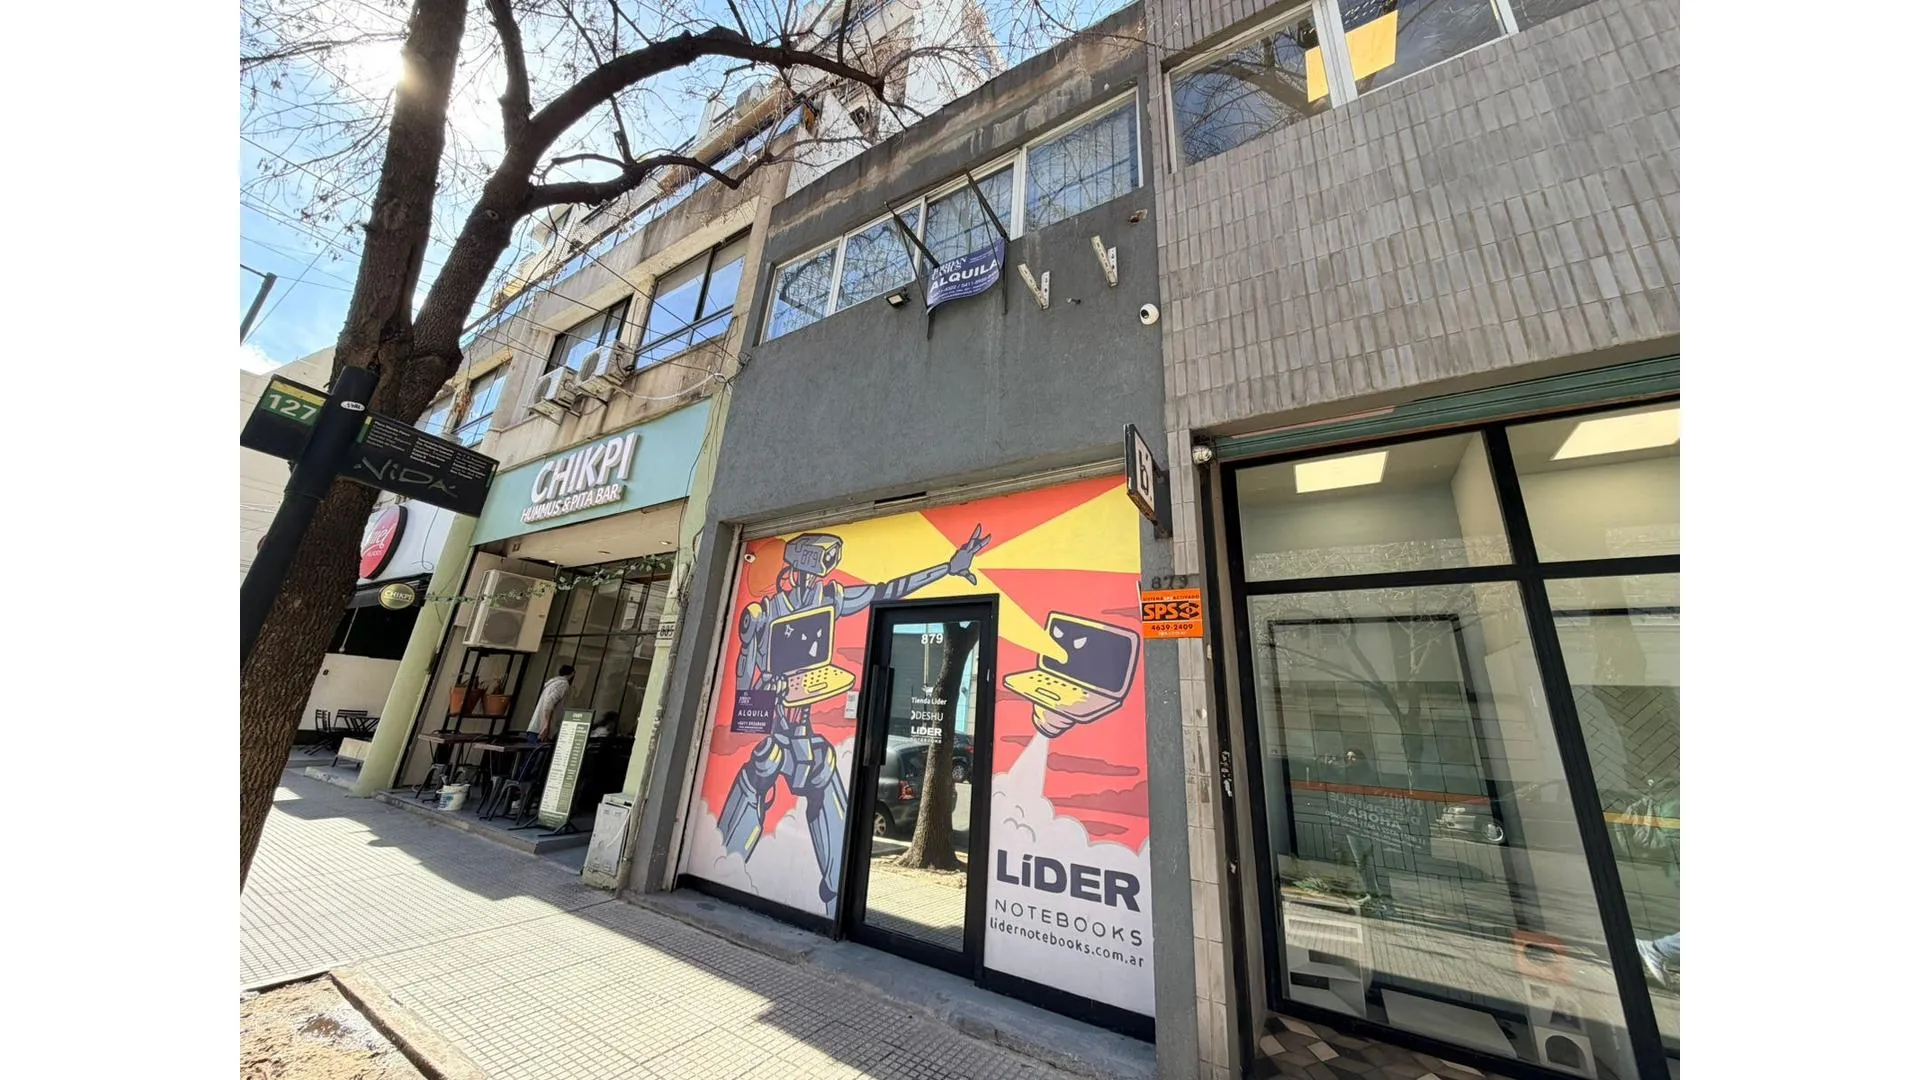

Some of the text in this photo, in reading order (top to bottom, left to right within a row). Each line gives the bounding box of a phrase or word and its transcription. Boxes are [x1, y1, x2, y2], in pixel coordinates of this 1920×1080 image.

[930, 259, 998, 292] ALQUILA
[269, 394, 317, 420] 127
[531, 432, 639, 504] CHIKPI
[520, 499, 563, 522] HUMMUS
[570, 490, 594, 511] PITA
[1143, 602, 1179, 620] SPS
[921, 633, 944, 644] 879
[737, 709, 769, 718] ALQUILA
[995, 899, 1143, 946] NOTEBOOKS
[990, 917, 1144, 968] lidernotebooks.com.ar
